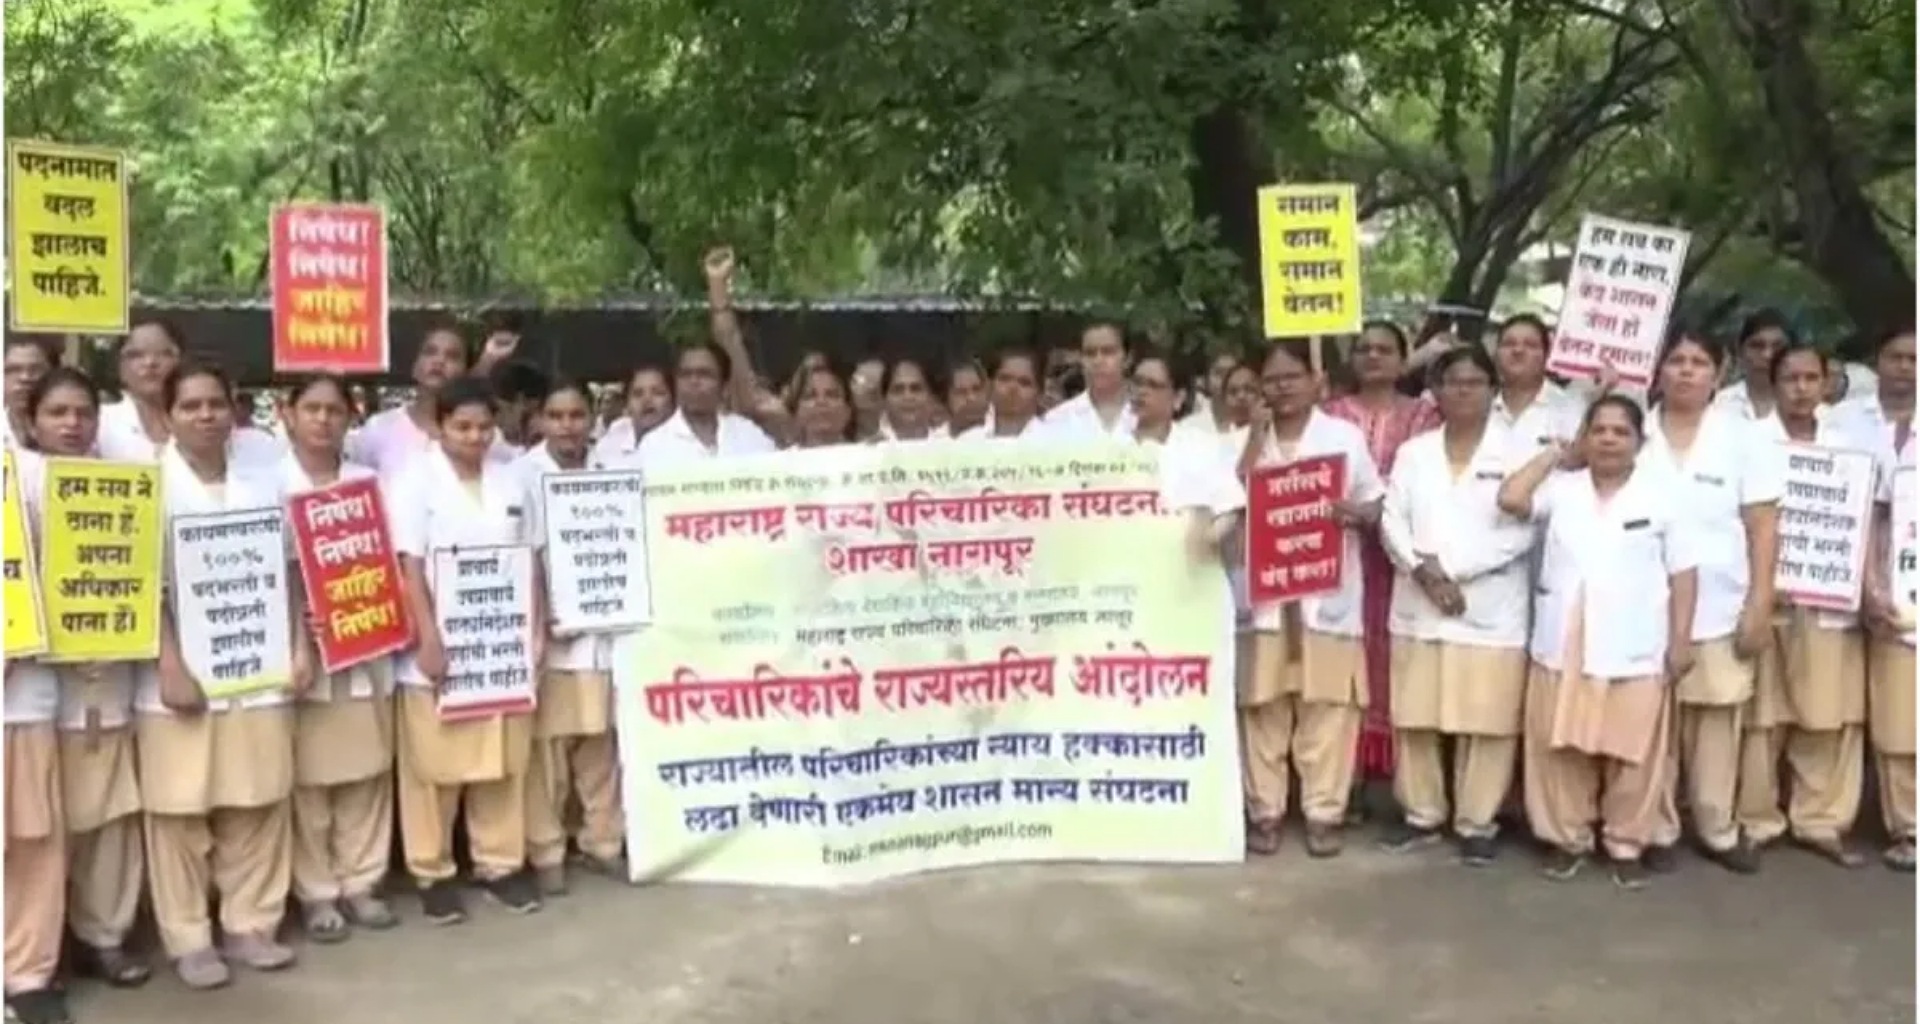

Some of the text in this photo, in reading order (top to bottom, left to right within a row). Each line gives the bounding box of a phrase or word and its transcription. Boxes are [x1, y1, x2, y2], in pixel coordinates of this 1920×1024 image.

[17, 152, 117, 182] पदनामात
[43, 192, 95, 220] बदल
[1277, 195, 1339, 215] समान
[31, 232, 107, 256] झालाच
[289, 212, 368, 246] निषेध!
[1590, 226, 1617, 246] हम
[1652, 235, 1675, 252] का
[289, 245, 368, 282] निषेध!
[1279, 260, 1343, 281] समान
[1282, 285, 1344, 314] वेतन!
[289, 313, 367, 349] निषेध!
[58, 476, 89, 499] हम
[137, 472, 153, 497] ने
[66, 511, 113, 532] ठाना
[305, 490, 375, 533] निषेध!
[665, 505, 786, 541] महाराष्ट्र
[795, 503, 875, 531] राज्य
[885, 487, 1052, 529] परिचारिका
[77, 545, 131, 564] अपना
[314, 527, 383, 569] निषेध!
[827, 537, 1034, 576] शाखा नागपूर
[60, 571, 143, 597] अधिकार
[324, 563, 388, 603] जाहिर
[62, 612, 107, 632] पाना
[331, 598, 398, 644] निषेध!
[645, 640, 1211, 725] परिचारिकांचे राज्यस्तरिय आंदोलन
[657, 724, 1206, 787] राज्यातील परिचारिकांच्या न्याय हक्कासाठी
[684, 770, 1189, 832] लढा देणारी एकमेव शासन मान्य संघटना
